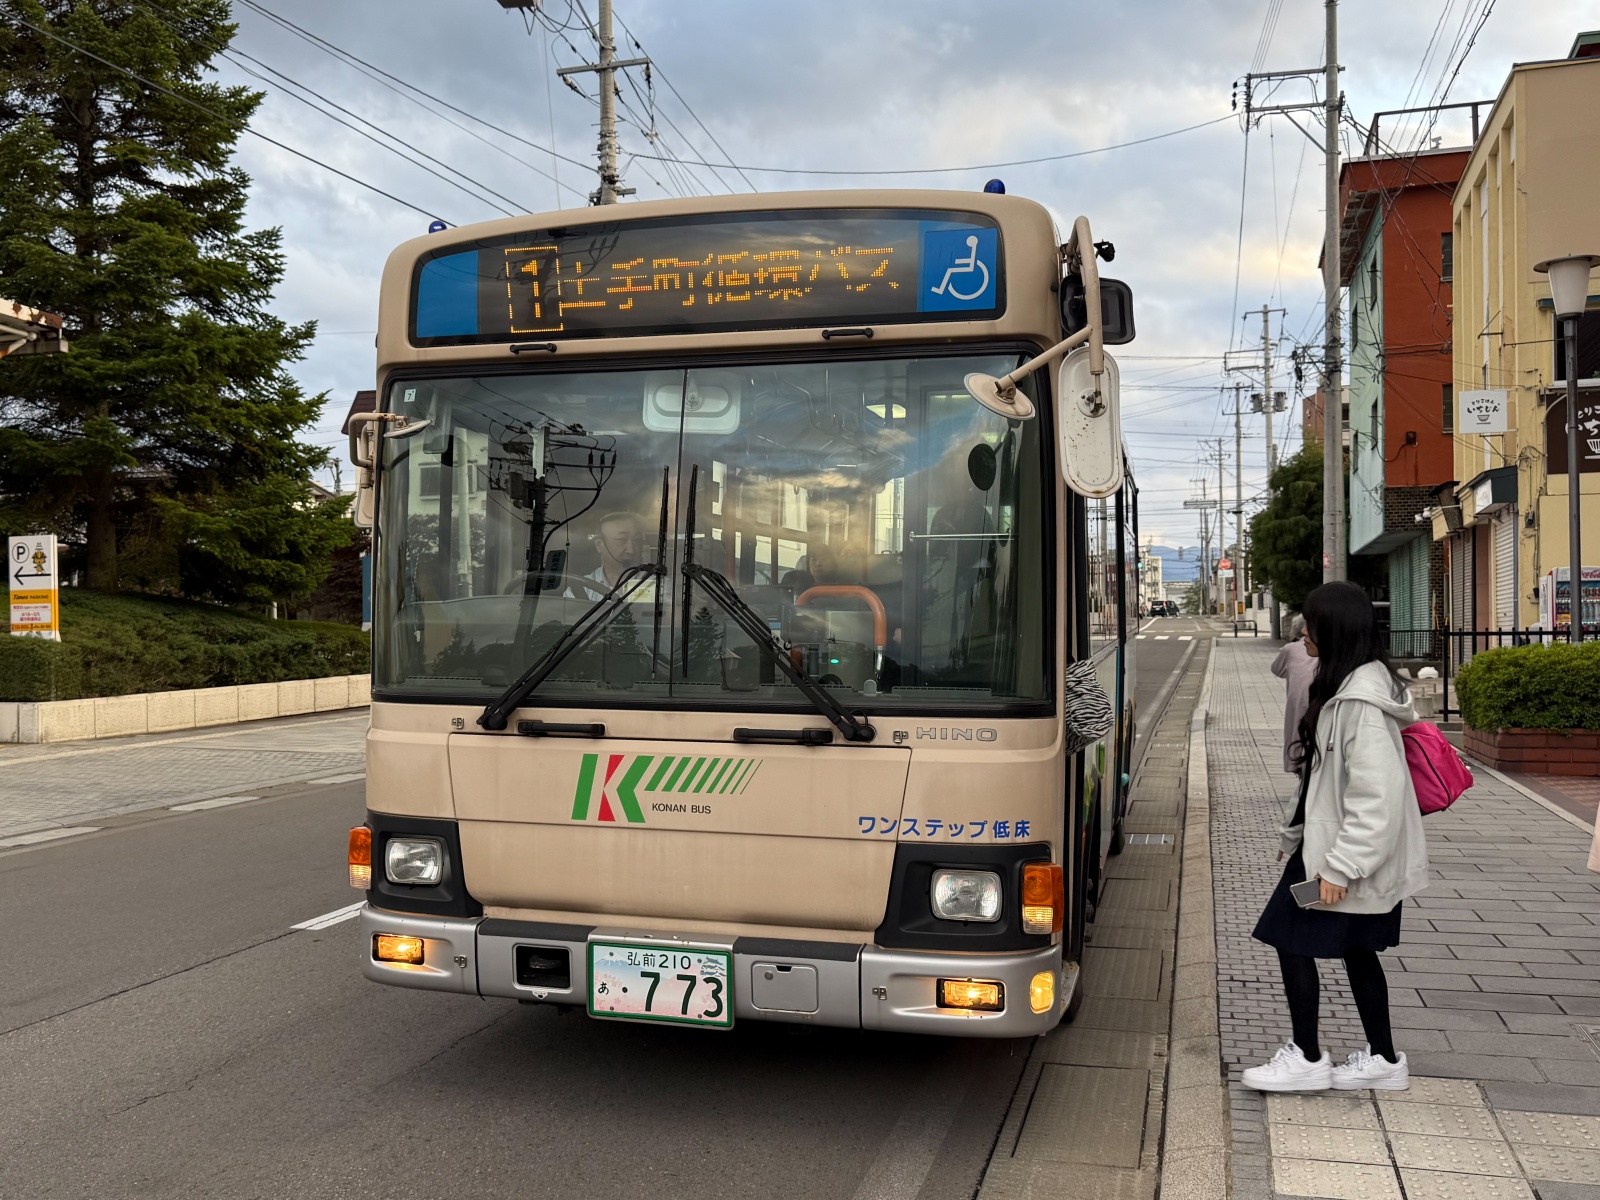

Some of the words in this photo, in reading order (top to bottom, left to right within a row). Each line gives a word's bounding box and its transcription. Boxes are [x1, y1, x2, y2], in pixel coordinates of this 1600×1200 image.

[916, 726, 998, 742] HINO
[652, 803, 687, 813] KONAN
[691, 804, 712, 814] BUS
[858, 816, 1031, 839] ワンステップ低床
[597, 982, 610, 995] あ
